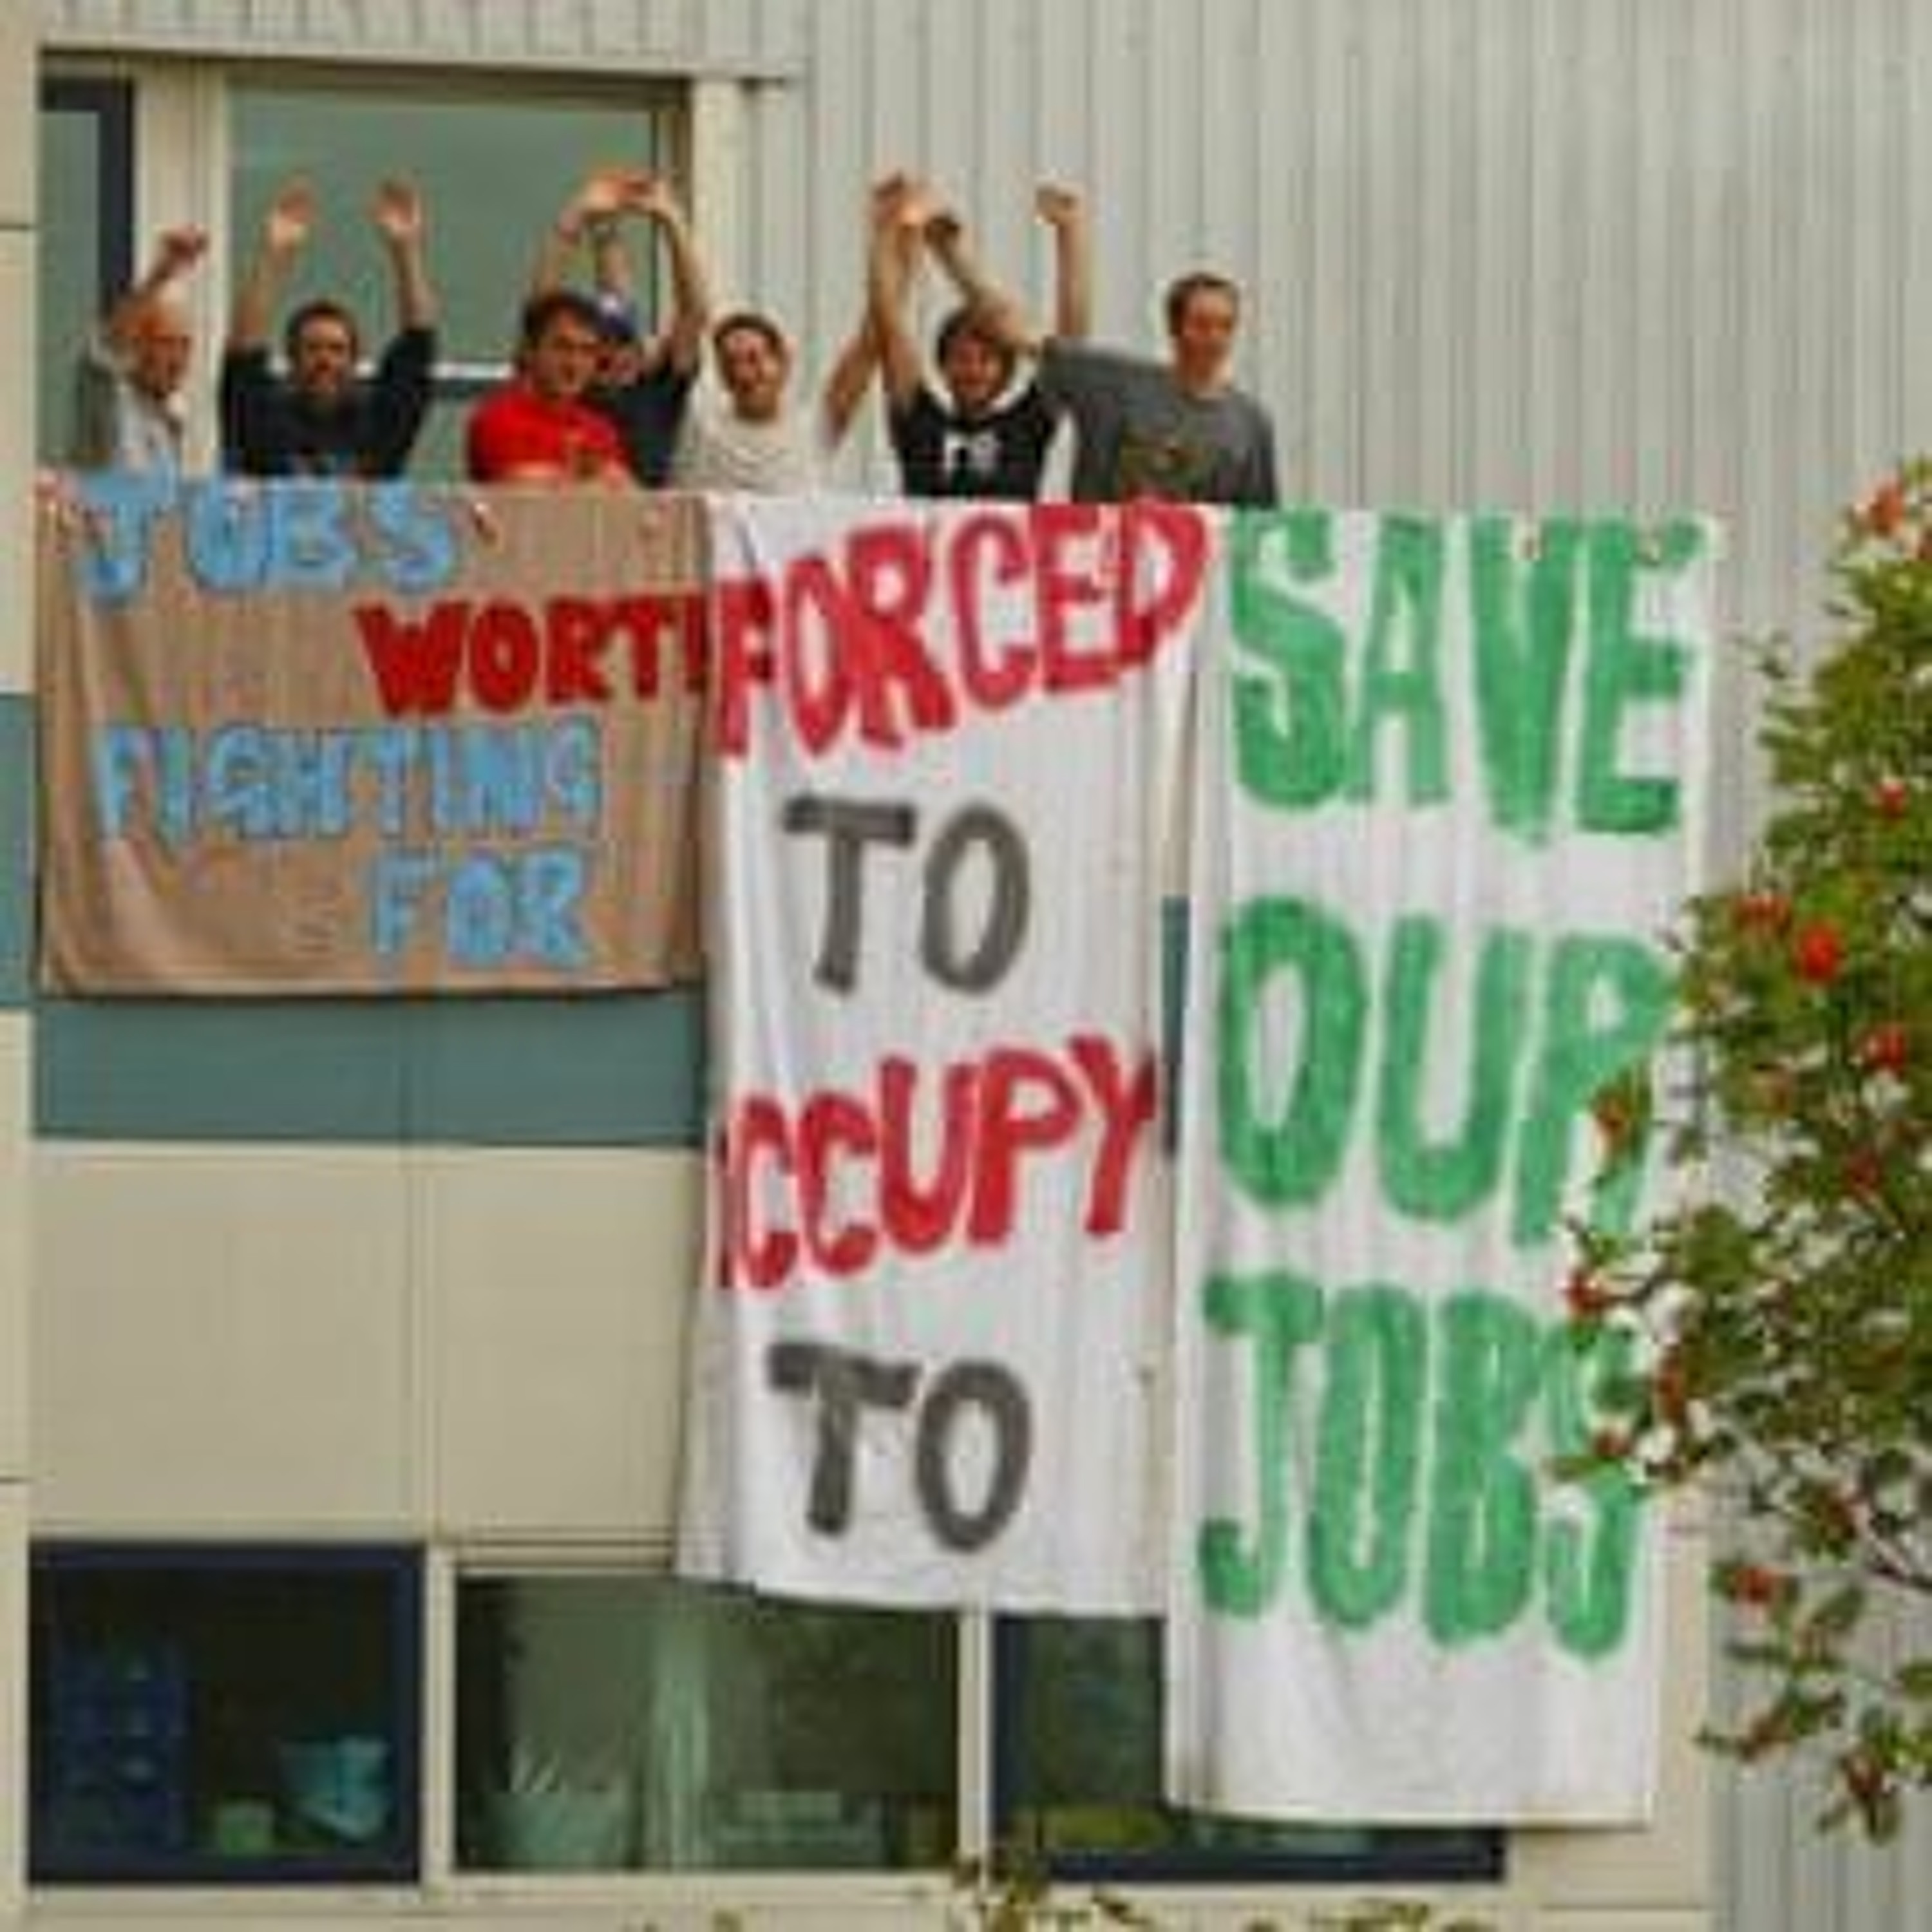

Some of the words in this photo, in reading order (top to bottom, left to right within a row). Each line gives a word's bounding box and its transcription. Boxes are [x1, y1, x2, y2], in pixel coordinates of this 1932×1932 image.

[718, 497, 1208, 757] FORCED
[1229, 507, 1703, 845] SAVE
[95, 720, 600, 844] FIGHTING
[782, 795, 1030, 995] TO
[367, 849, 587, 969] FOR
[1219, 897, 1671, 1246] OUR
[766, 1341, 1032, 1554] TO
[1199, 1272, 1645, 1656] JOBS
